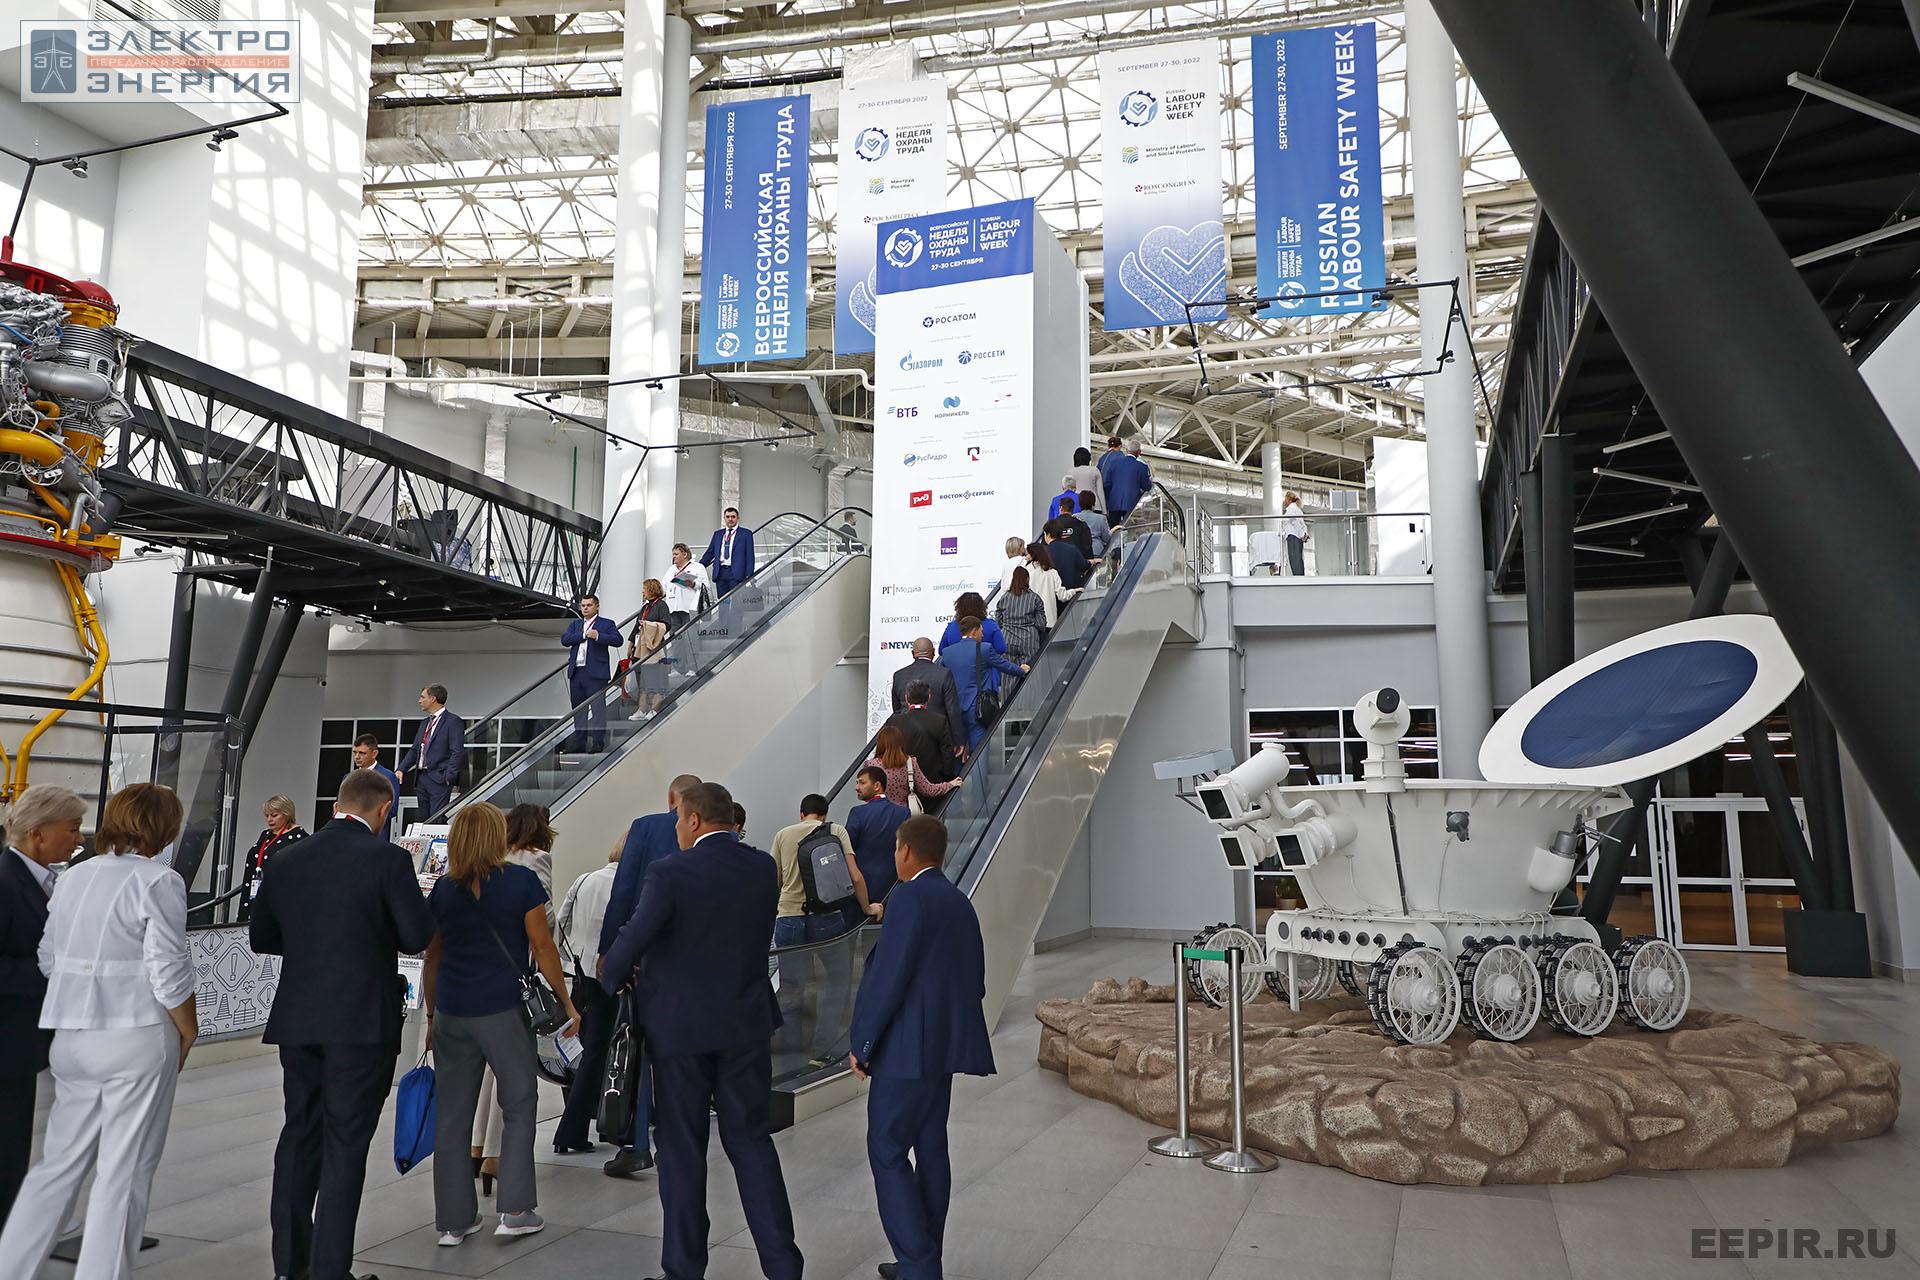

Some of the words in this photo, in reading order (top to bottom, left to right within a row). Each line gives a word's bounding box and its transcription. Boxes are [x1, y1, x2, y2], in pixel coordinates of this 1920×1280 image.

[1276, 38, 1286, 62] 2022
[1118, 62, 1159, 72] SEPTEMBER
[1160, 59, 1182, 68] 27-30,
[1183, 57, 1201, 65] 2022
[1334, 29, 1356, 101] WEEK
[1277, 63, 1287, 92] 27-30,
[876, 97, 911, 107] СЕНТЯБРЯ
[912, 95, 929, 103] 2022
[1166, 92, 1206, 103] LABOUR
[1166, 101, 1202, 112] SAFETY
[727, 111, 735, 133] 2022
[1166, 110, 1194, 120] WEEK
[1278, 94, 1288, 150] SEPTEMBER
[776, 104, 795, 172] ТРУДА
[896, 128, 932, 139] НЕДЕЛЯ
[895, 136, 933, 147] ОХРАНЫ
[896, 145, 925, 155] ТРУДА
[1175, 147, 1206, 155] Protection
[1337, 107, 1360, 198] SAFETY
[725, 135, 735, 182] СЕНТЯБРЯ
[725, 184, 733, 210] 27-30
[774, 176, 792, 265] ОХРАНЫ
[980, 218, 1021, 232] LABOUR
[929, 226, 968, 241] НЕДЕЛЯ
[979, 228, 1017, 242] SAFETY
[929, 236, 969, 250] ОХРАНЫ
[979, 239, 1009, 251] WEEK
[929, 247, 961, 259] ТРУДА
[1317, 203, 1340, 308] RUSSIAN
[1340, 204, 1363, 307] LABOUR
[753, 172, 774, 355] ВСЕРОССИЙСКАЯ
[930, 262, 949, 271] 27-30
[949, 256, 984, 268] СЕНТЯБРЯ
[772, 270, 791, 354] НЕДЕЛЯ
[935, 312, 977, 325] РОСАТОМ
[973, 349, 1006, 360] РОССЕТИ
[896, 406, 919, 418] ВТБ
[934, 410, 970, 419] НОРНИКЕЛЬ
